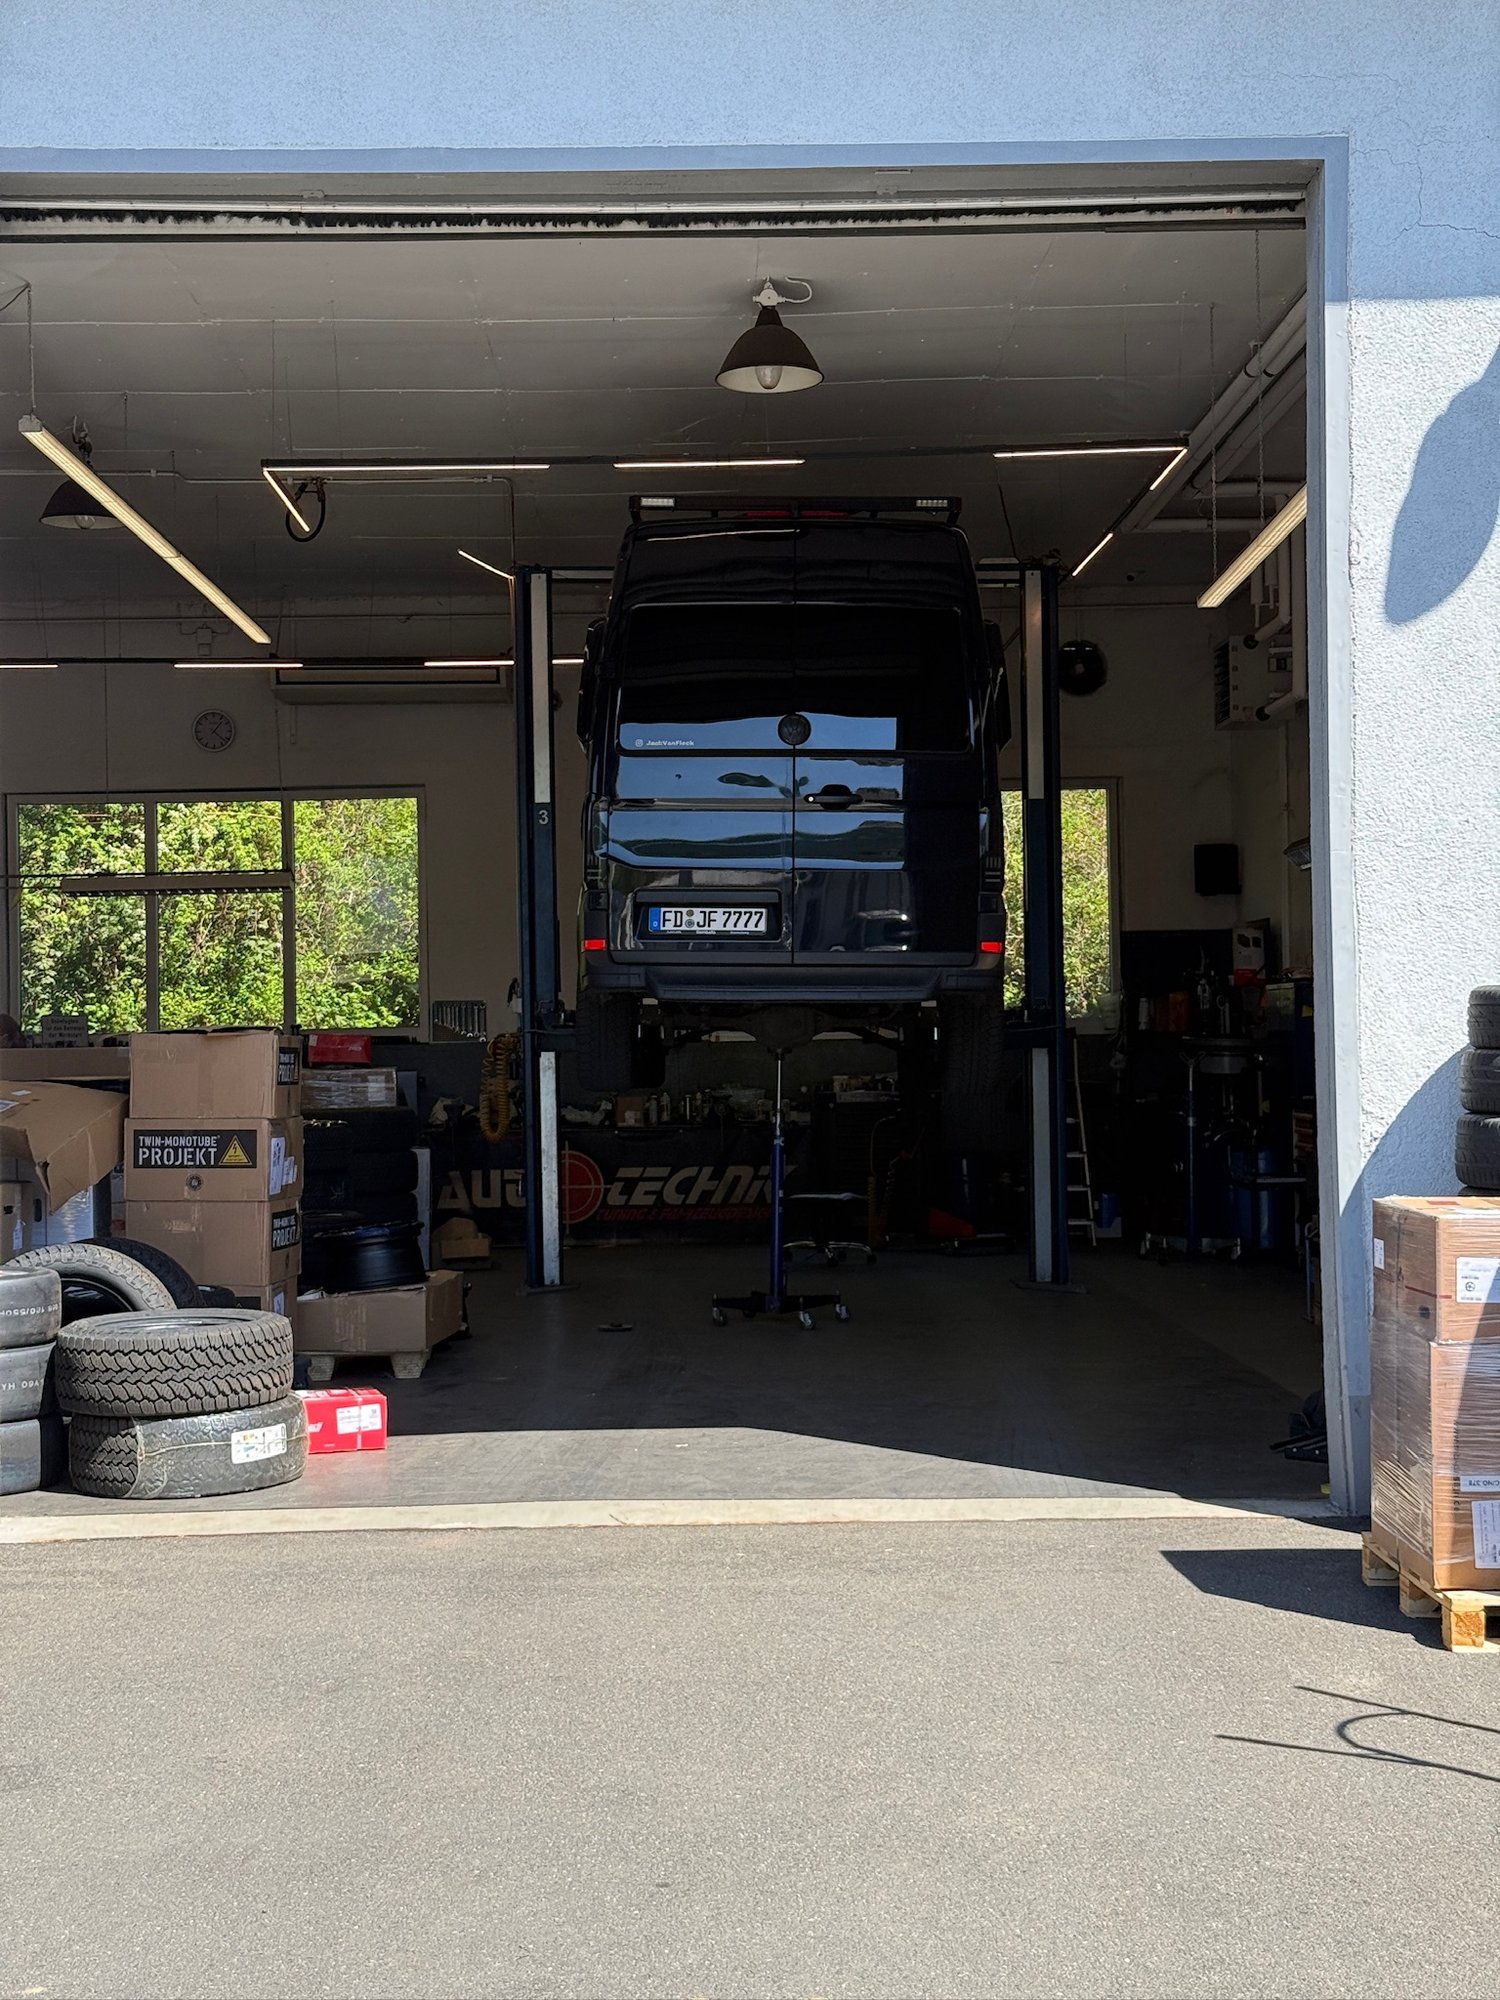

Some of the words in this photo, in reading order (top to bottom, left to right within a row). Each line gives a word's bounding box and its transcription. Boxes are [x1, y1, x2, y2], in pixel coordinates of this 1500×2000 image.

[538, 809, 549, 825] 3
[662, 910, 683, 928] FD
[697, 910, 718, 928] JF
[722, 910, 764, 928] 7777
[138, 1135, 218, 1147] TWIN-MONOTUBE
[138, 1148, 218, 1166] PROJEKT
[660, 1206, 771, 1221] FAHRZEUGDESIG
